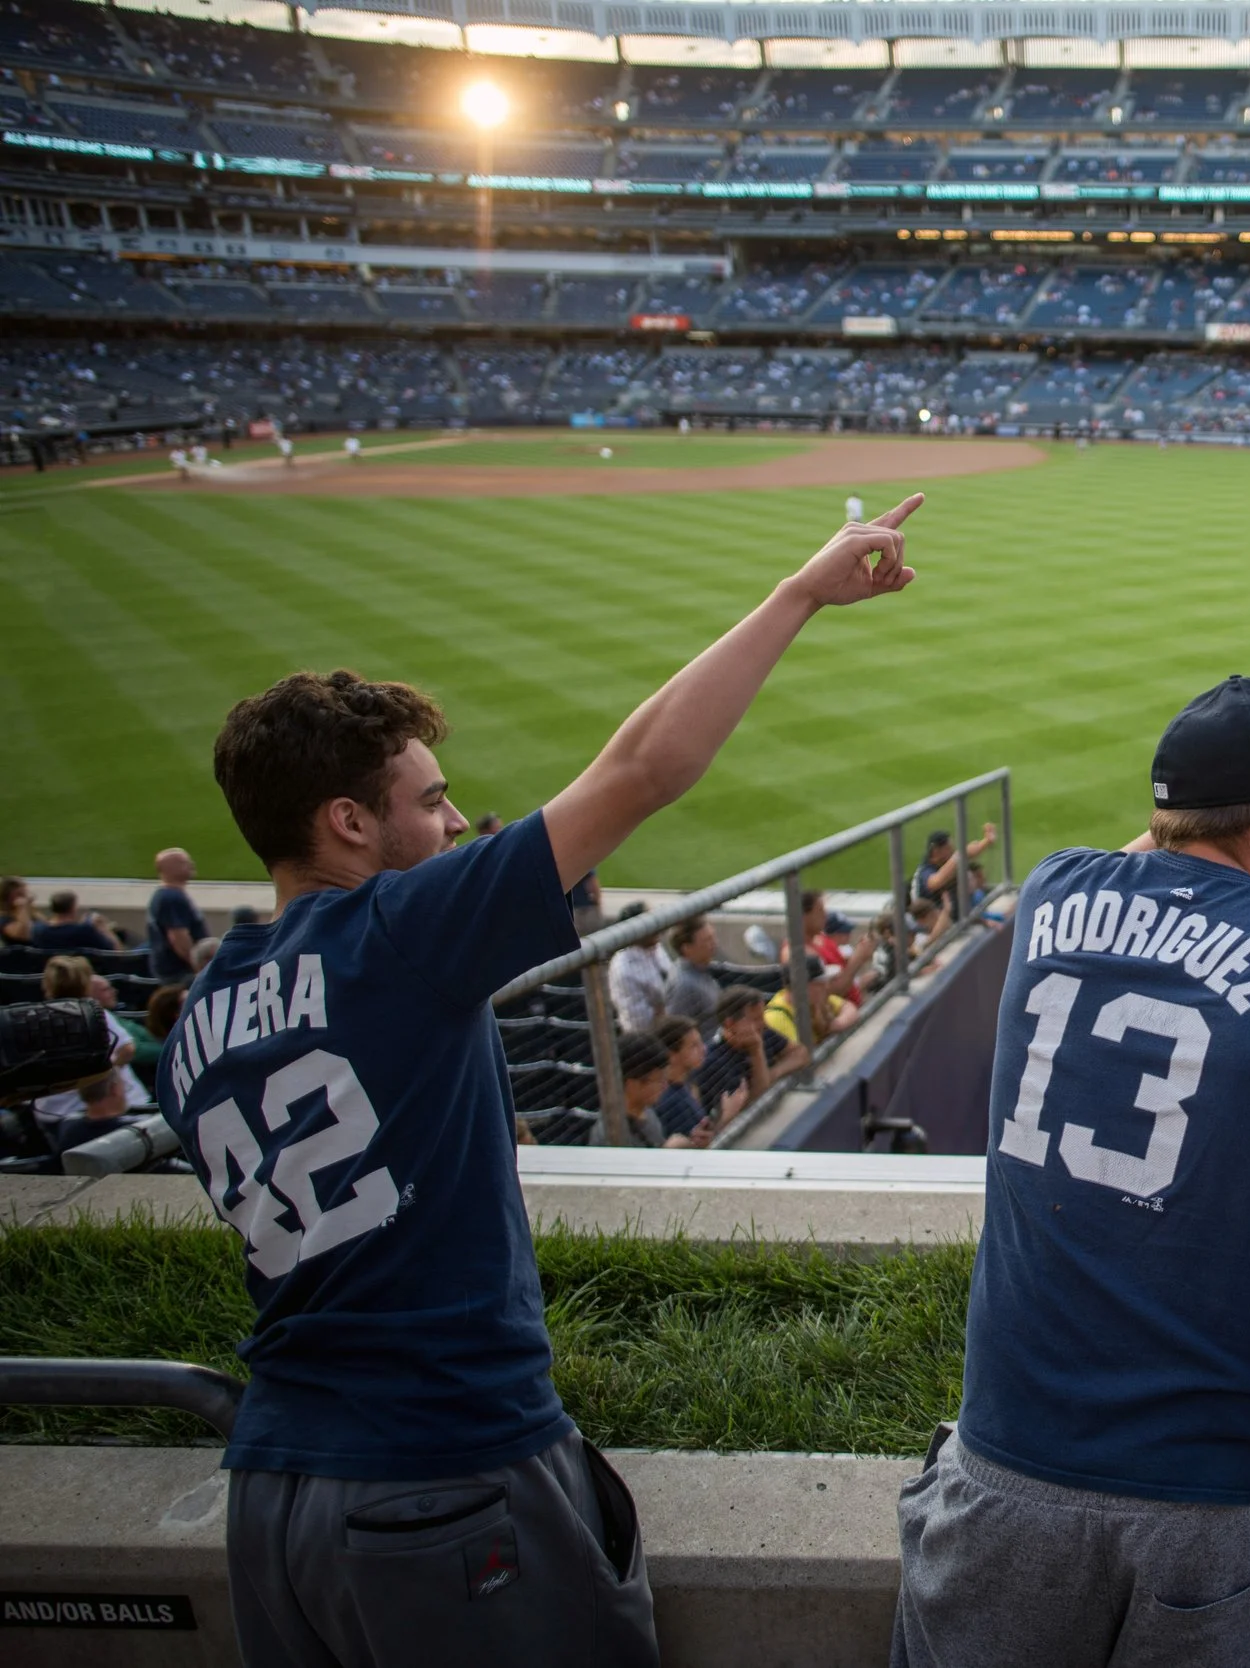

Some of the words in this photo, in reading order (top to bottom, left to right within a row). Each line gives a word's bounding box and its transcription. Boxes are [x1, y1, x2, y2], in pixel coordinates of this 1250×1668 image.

[171, 952, 328, 1114] RIVERA
[998, 972, 1212, 1199] 13
[196, 1048, 402, 1280] 42
[4, 1600, 96, 1622] AND/OR
[99, 1603, 175, 1623] BALLS
